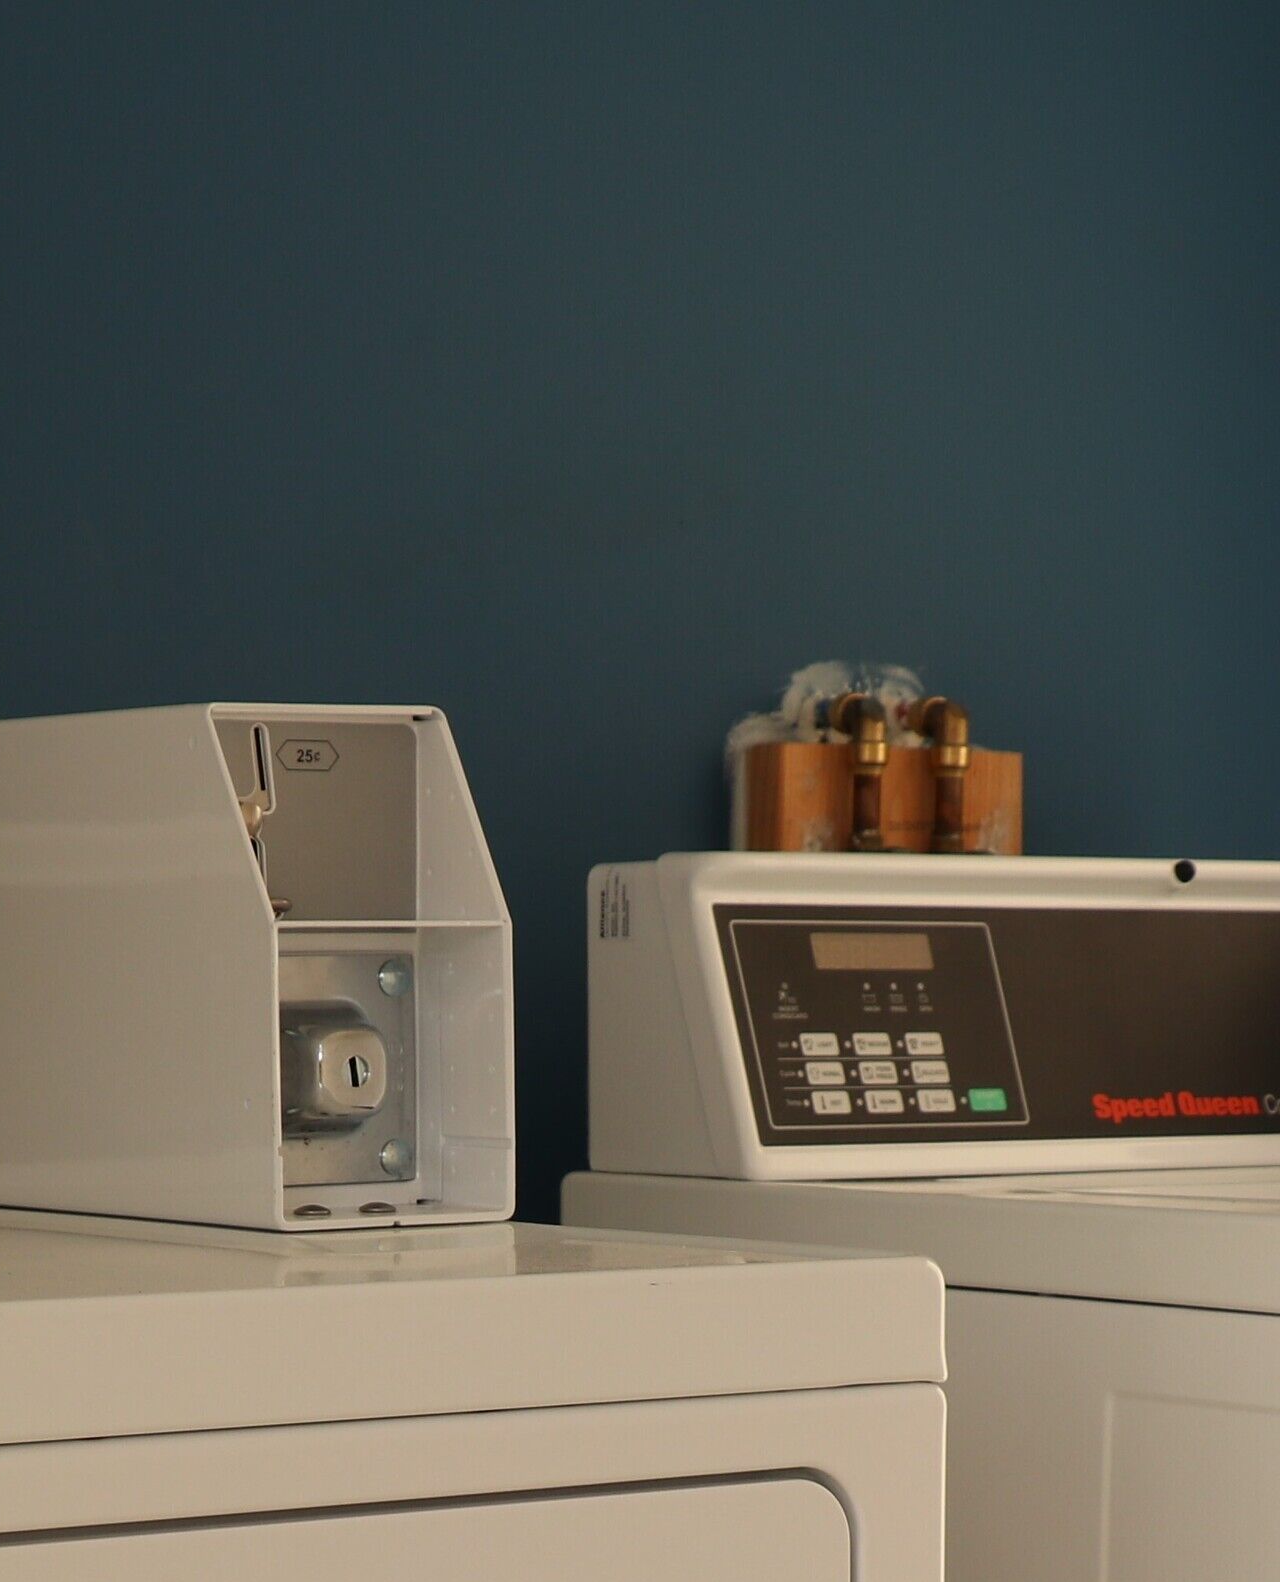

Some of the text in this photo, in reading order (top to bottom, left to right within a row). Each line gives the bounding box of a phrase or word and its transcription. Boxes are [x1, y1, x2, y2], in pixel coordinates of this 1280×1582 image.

[297, 749, 320, 763] 25¢
[1092, 1091, 1176, 1124] Speed
[1177, 1090, 1260, 1116] Queen
